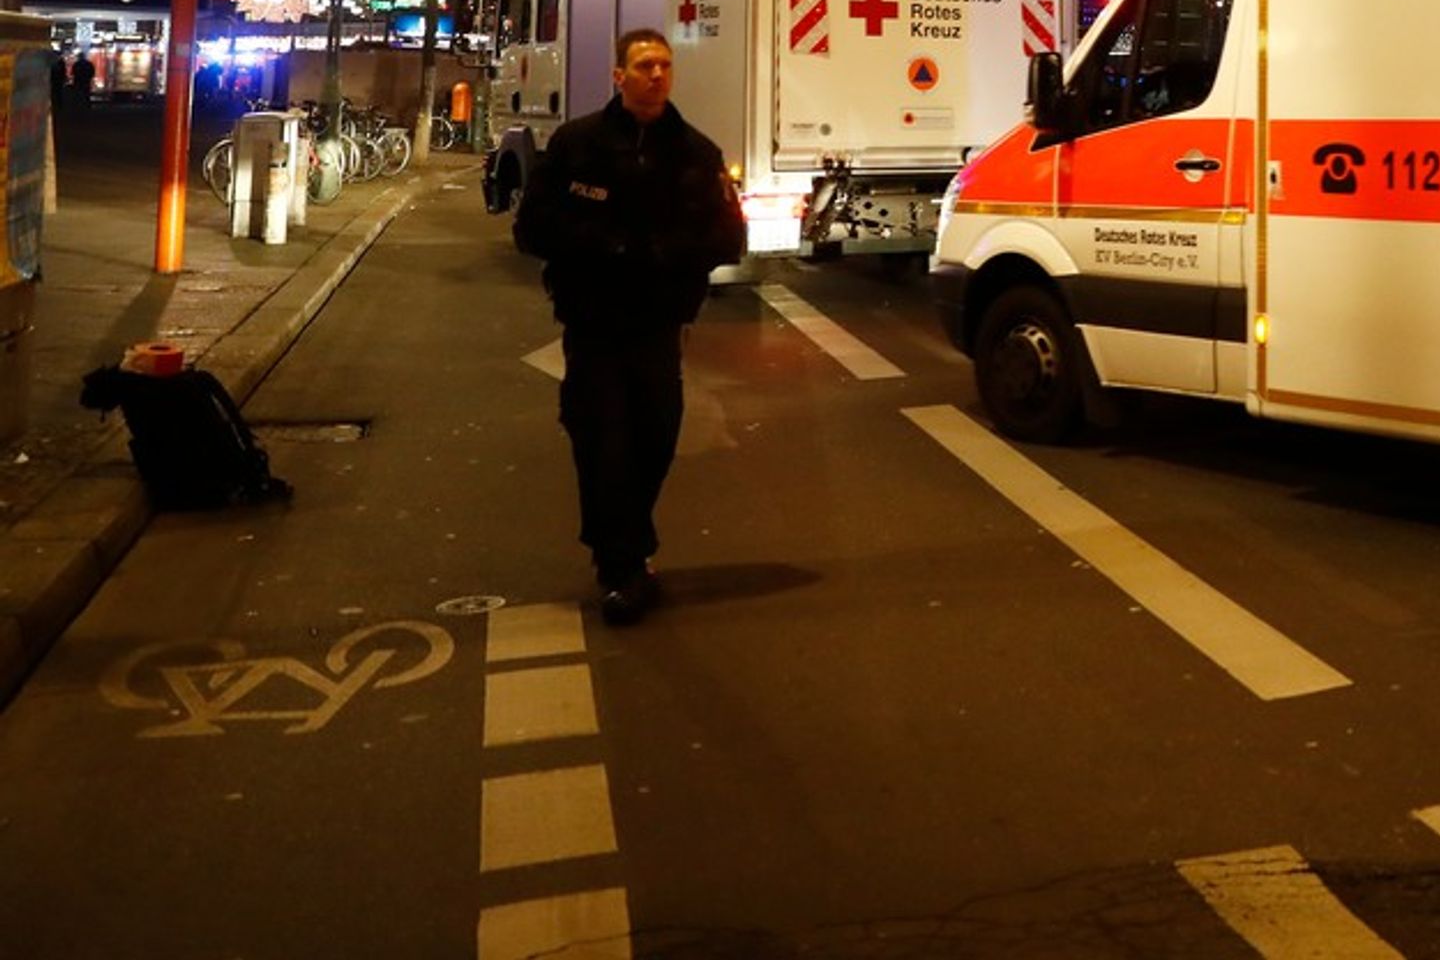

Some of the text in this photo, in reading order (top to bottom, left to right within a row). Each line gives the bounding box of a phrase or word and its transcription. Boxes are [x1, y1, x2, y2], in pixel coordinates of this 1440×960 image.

[909, 3, 962, 21] Rotes
[909, 22, 962, 40] Kreuz
[568, 180, 609, 201] POLIZEI
[1094, 227, 1198, 247] Deutsches Rotes Kreuz
